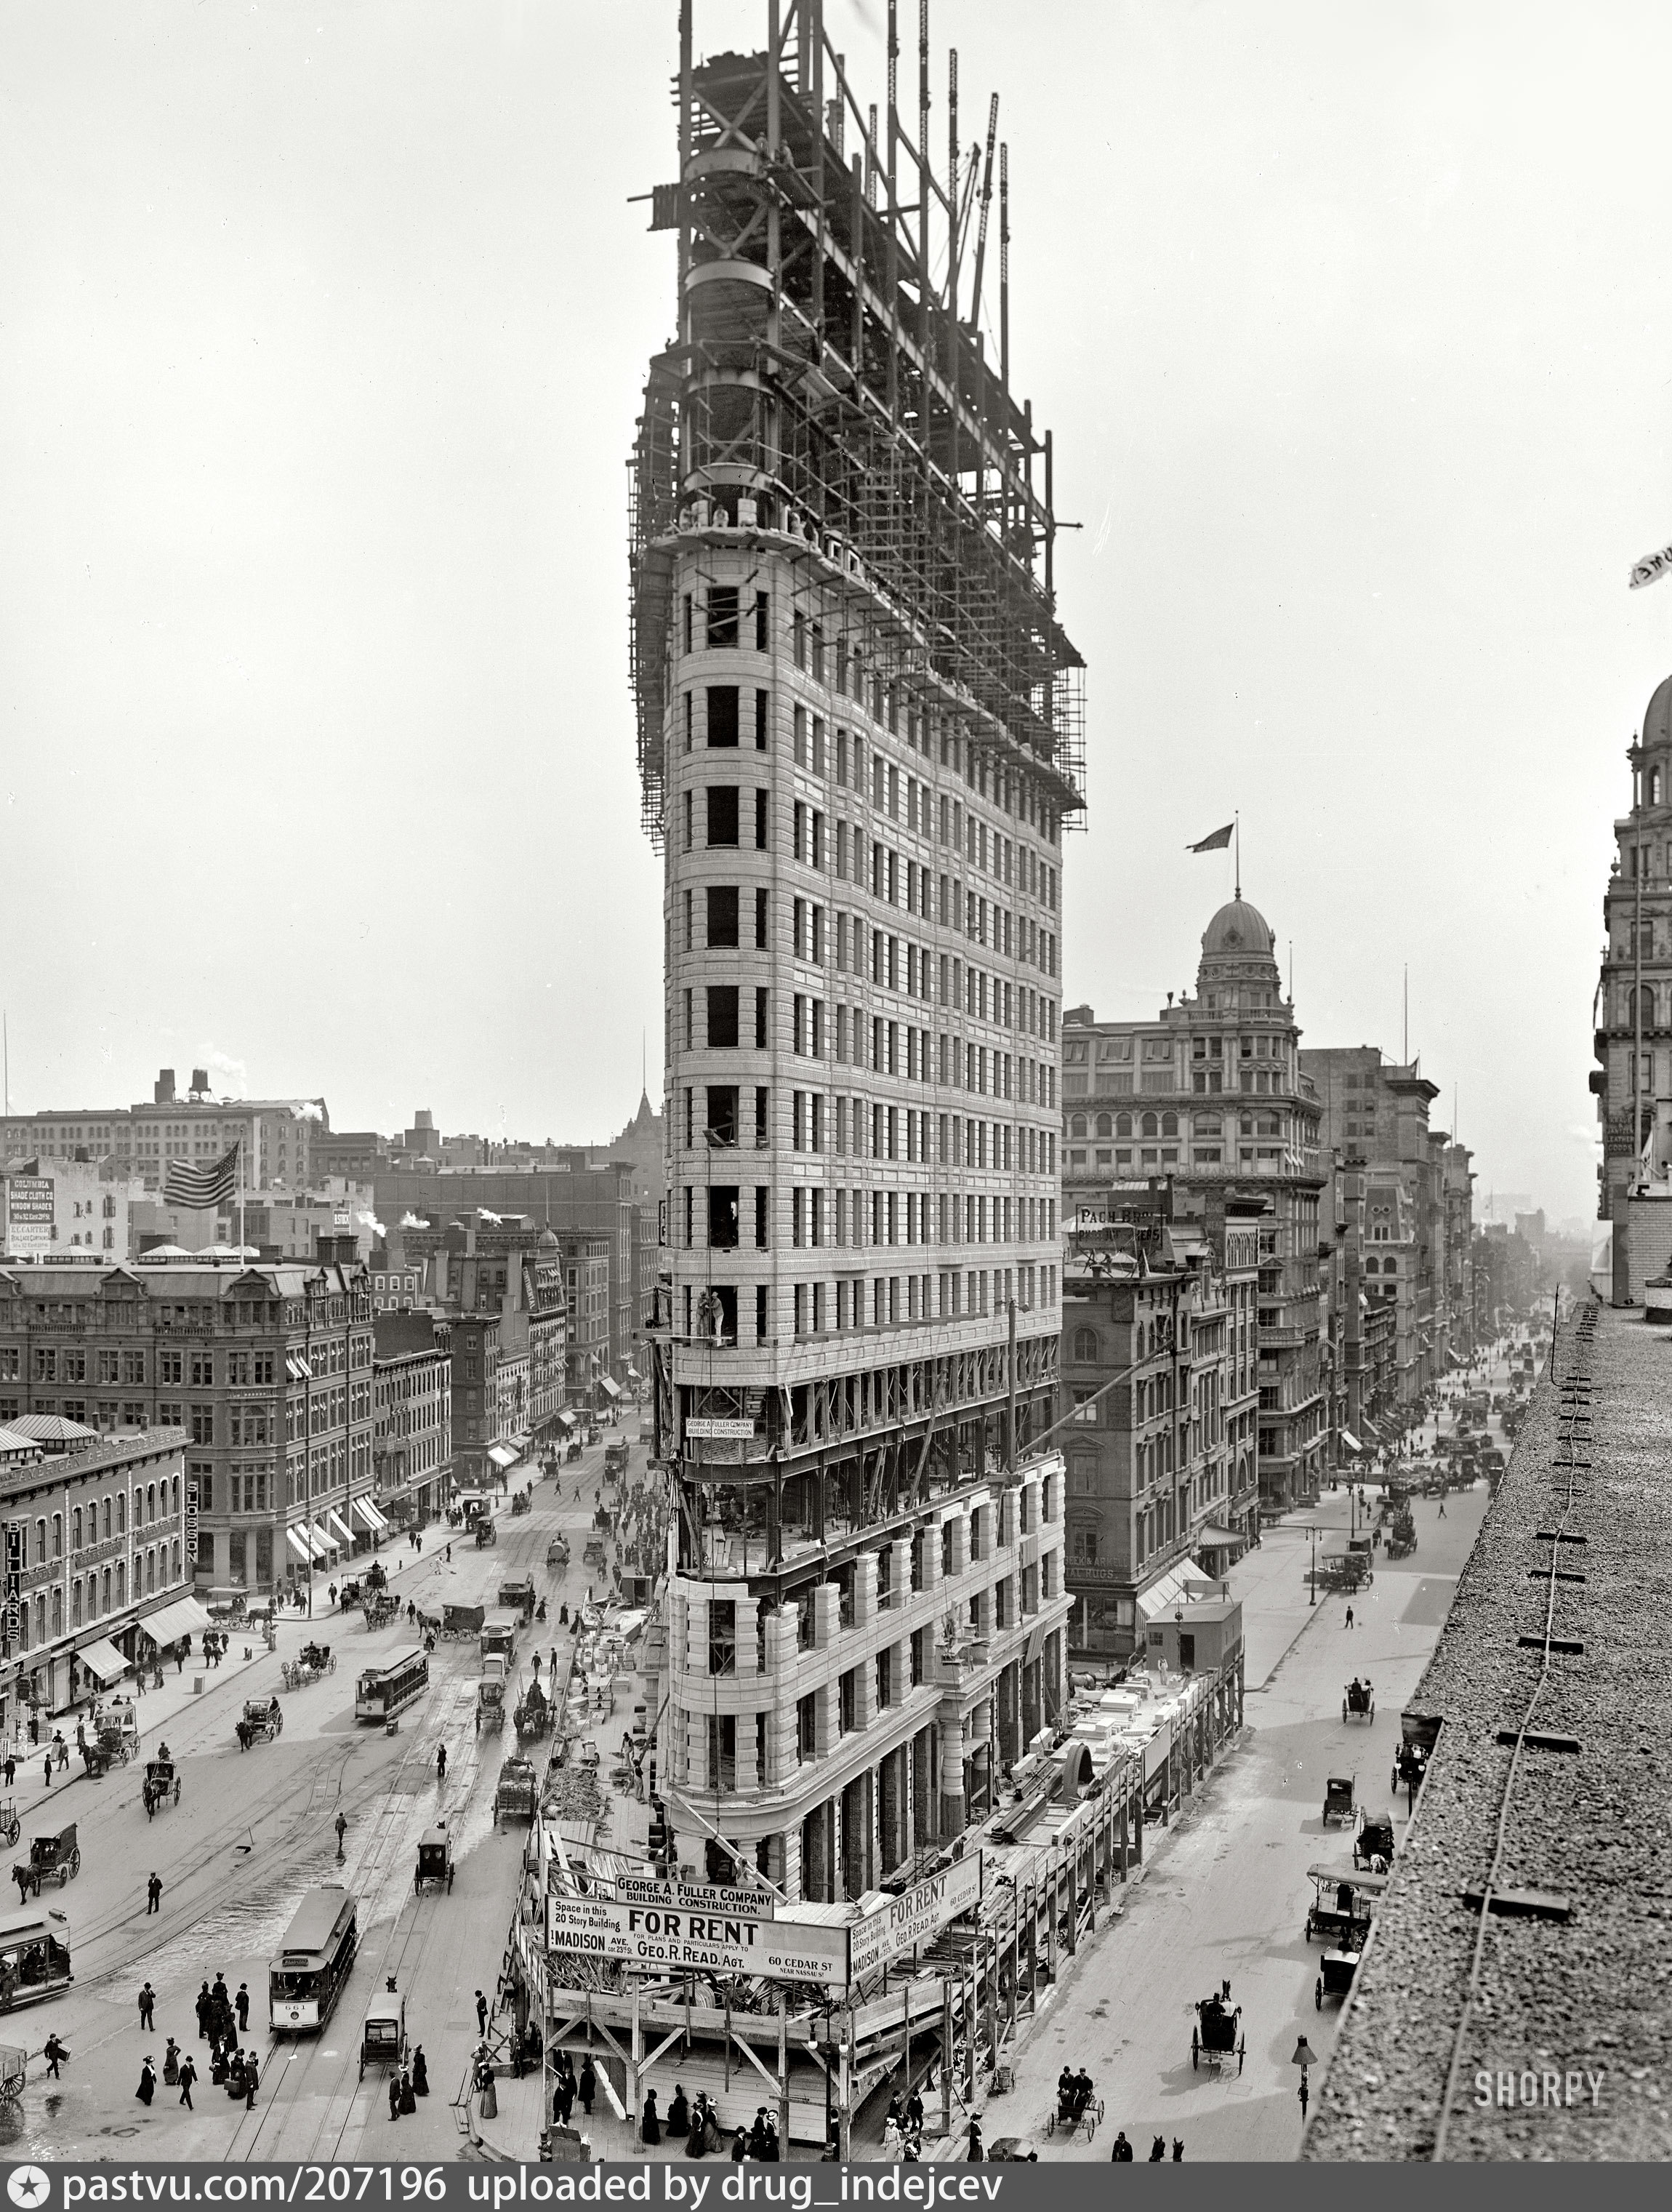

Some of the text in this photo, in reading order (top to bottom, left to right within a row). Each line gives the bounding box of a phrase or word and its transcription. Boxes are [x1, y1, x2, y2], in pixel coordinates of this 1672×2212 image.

[10, 1191, 28, 1200] SHADE
[29, 1191, 45, 1200] CLOTH
[1081, 1209, 1115, 1223] PACH
[522, 1266, 535, 1310] CONTINENTAL
[19, 1455, 81, 1483] AMERICAN
[188, 1482, 198, 1563] SLOSSON
[7, 1520, 20, 1642] BILLIARDS
[618, 1877, 771, 1906] GEORGE A. FULLER COMPANY
[891, 1875, 947, 1928] FOR RENT
[950, 1897, 956, 1907] 60
[957, 1887, 971, 1902] CEDAR
[555, 1901, 607, 1916] Space in this
[626, 1891, 760, 1915] BUILDING CONSTRUCTION.
[555, 1913, 621, 1933] 20 Story Building
[629, 1910, 758, 1945] FOR RENT
[853, 1926, 867, 1940] Space
[867, 1921, 872, 1931] in
[555, 1931, 605, 1951] MADISON
[611, 1937, 629, 1946] AVE.
[683, 1939, 720, 1949] PARTICULARS
[853, 1940, 859, 1952] 20
[859, 1936, 869, 1949] Story
[768, 1956, 781, 1966] 60
[784, 1958, 819, 1971] CEDAR
[853, 1946, 879, 1976] MADISON
